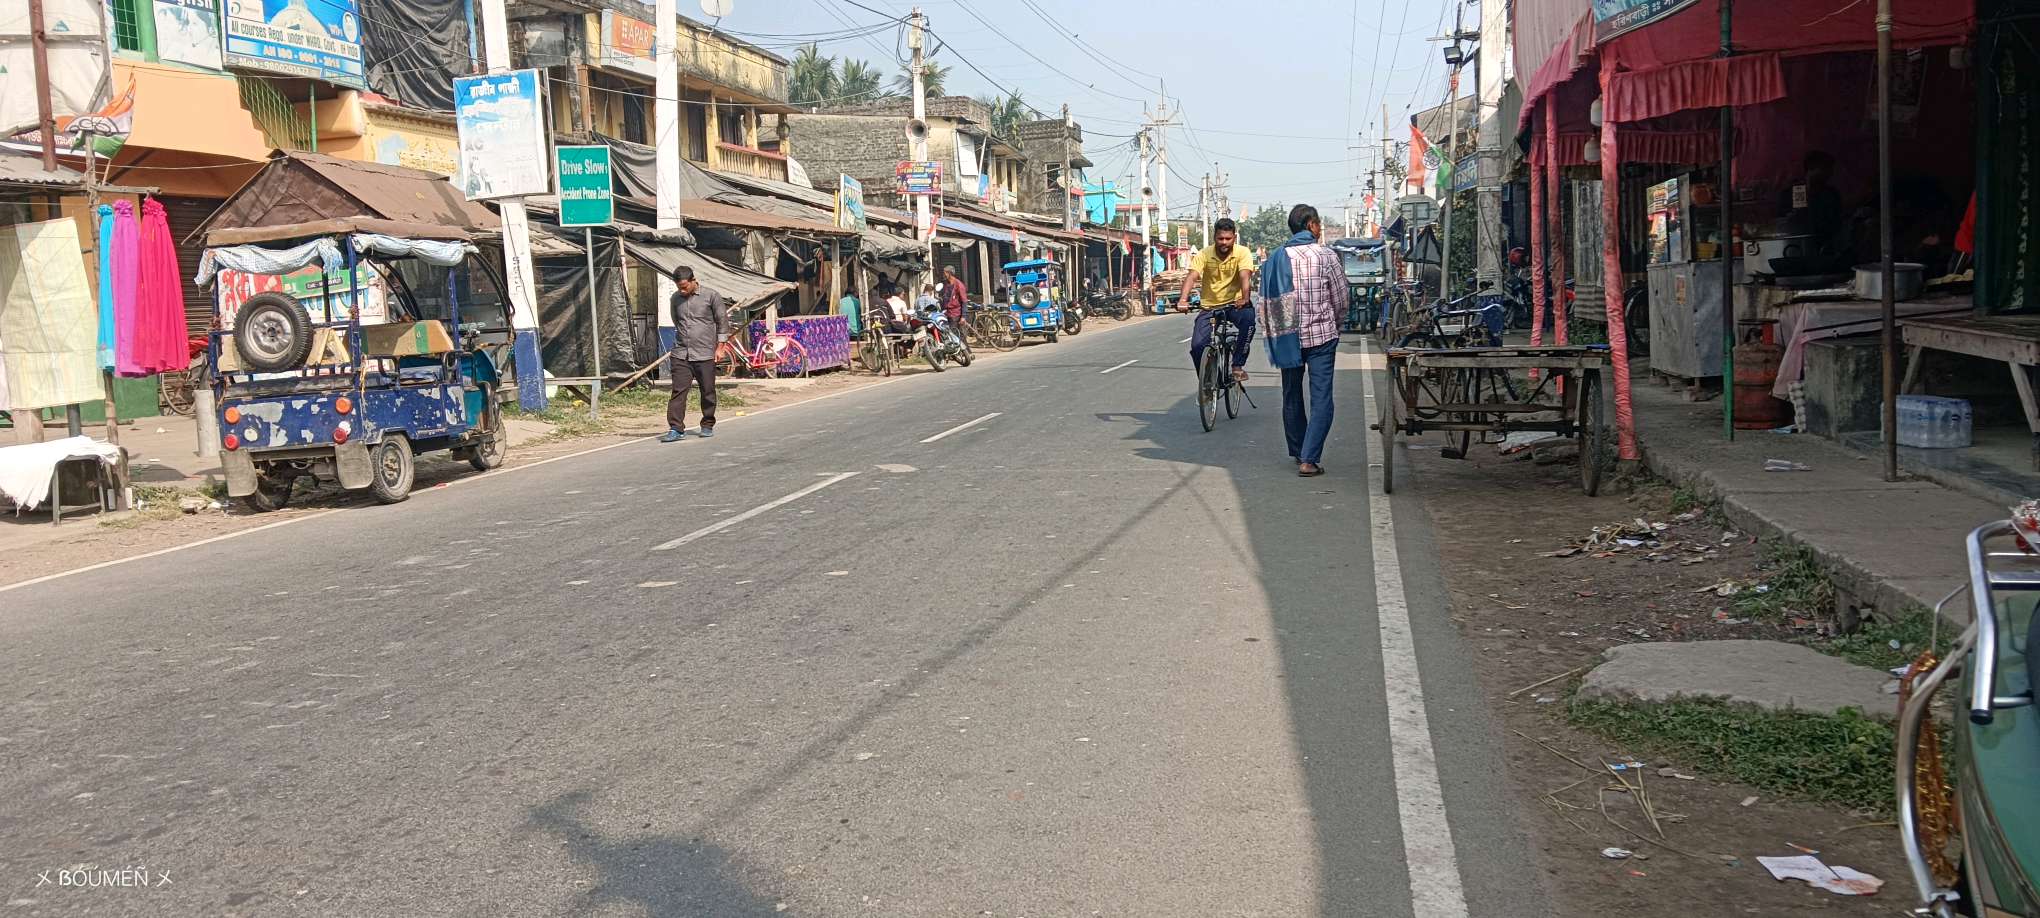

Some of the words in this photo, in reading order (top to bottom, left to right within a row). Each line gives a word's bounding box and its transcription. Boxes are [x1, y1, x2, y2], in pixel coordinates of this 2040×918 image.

[241, 23, 266, 39] courses
[561, 159, 583, 175] Drive
[560, 186, 583, 200] Accident
[583, 186, 597, 200] Prone
[597, 186, 610, 200] Zone
